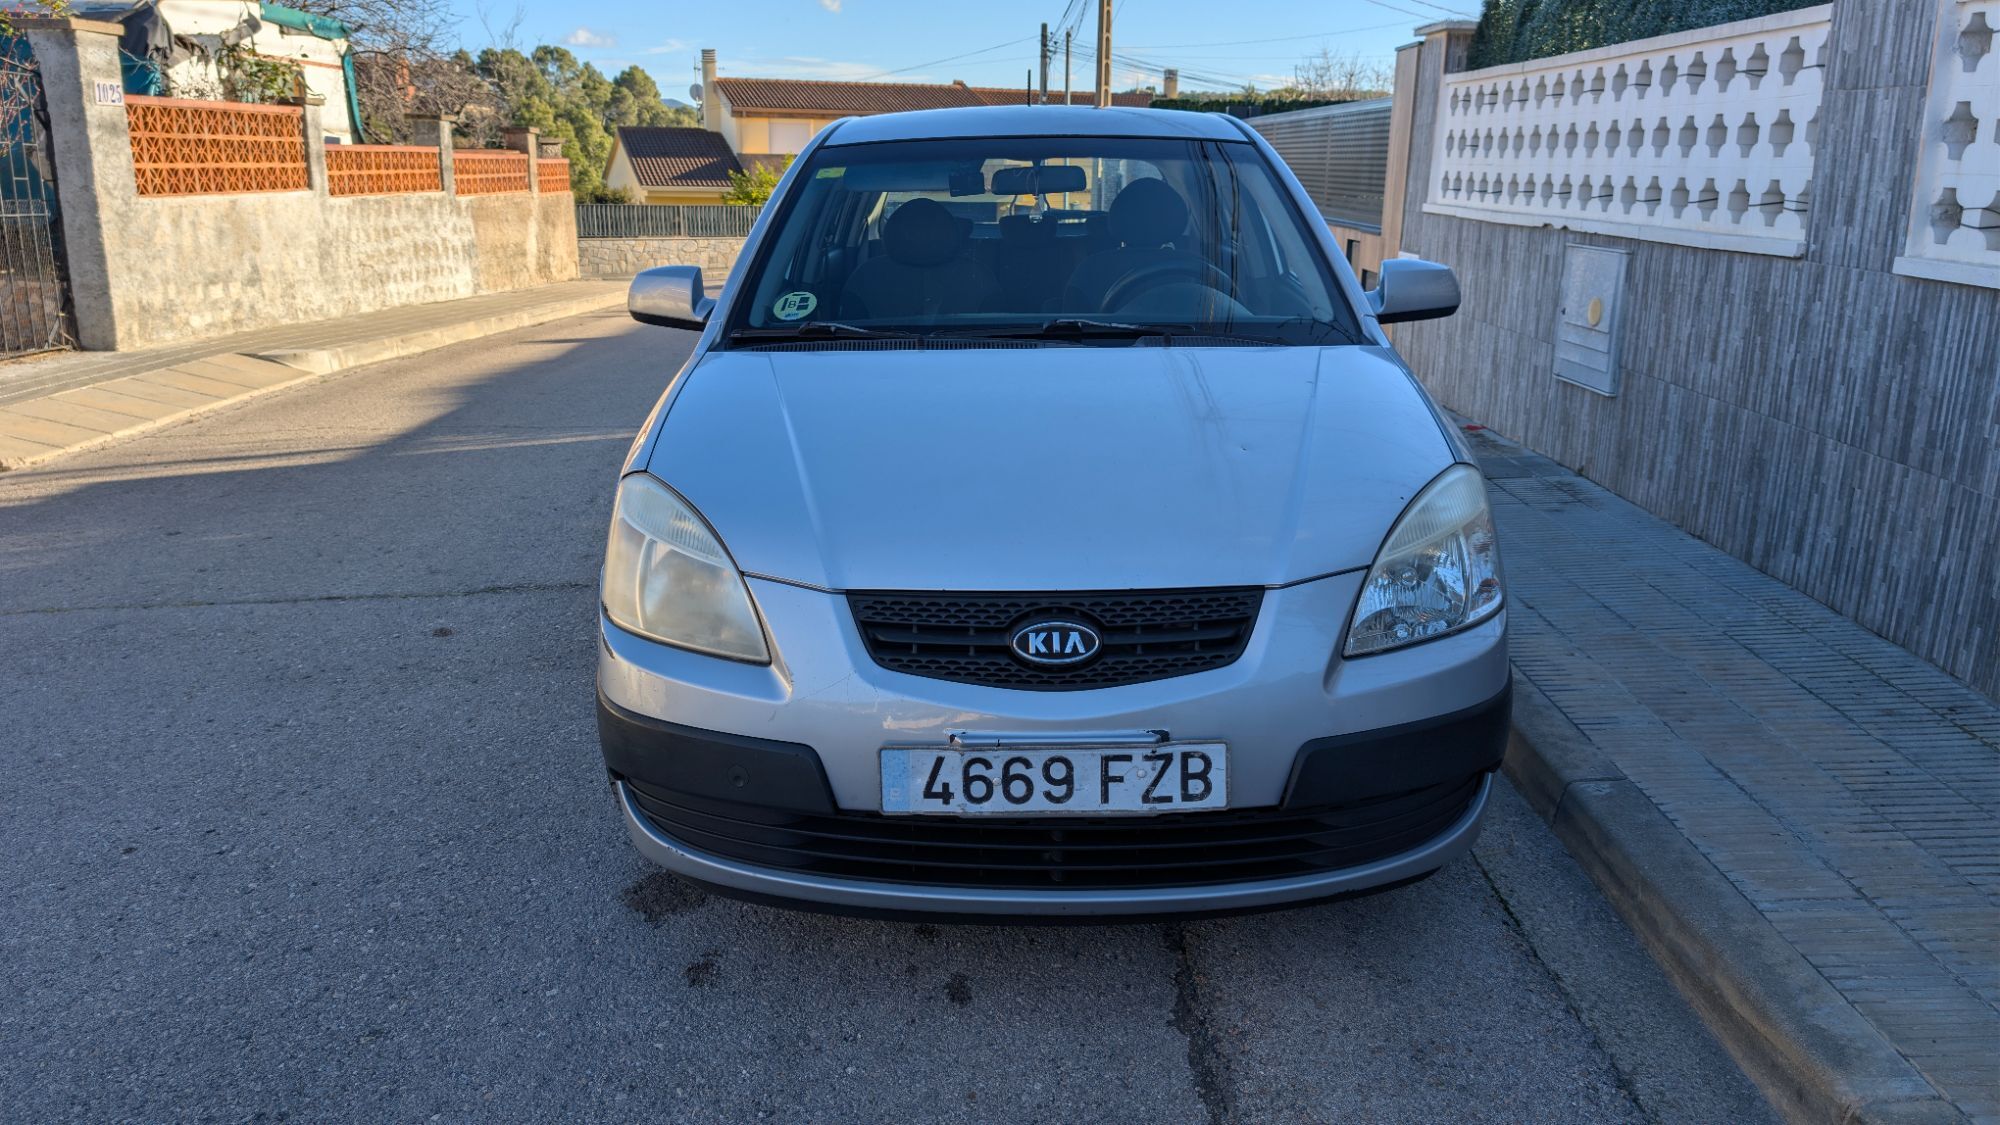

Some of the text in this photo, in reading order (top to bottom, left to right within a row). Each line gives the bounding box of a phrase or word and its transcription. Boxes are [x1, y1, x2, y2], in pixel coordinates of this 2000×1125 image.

[96, 83, 122, 103] 1025
[1028, 631, 1086, 654] KIA
[923, 751, 1212, 805] 4669 FZB
